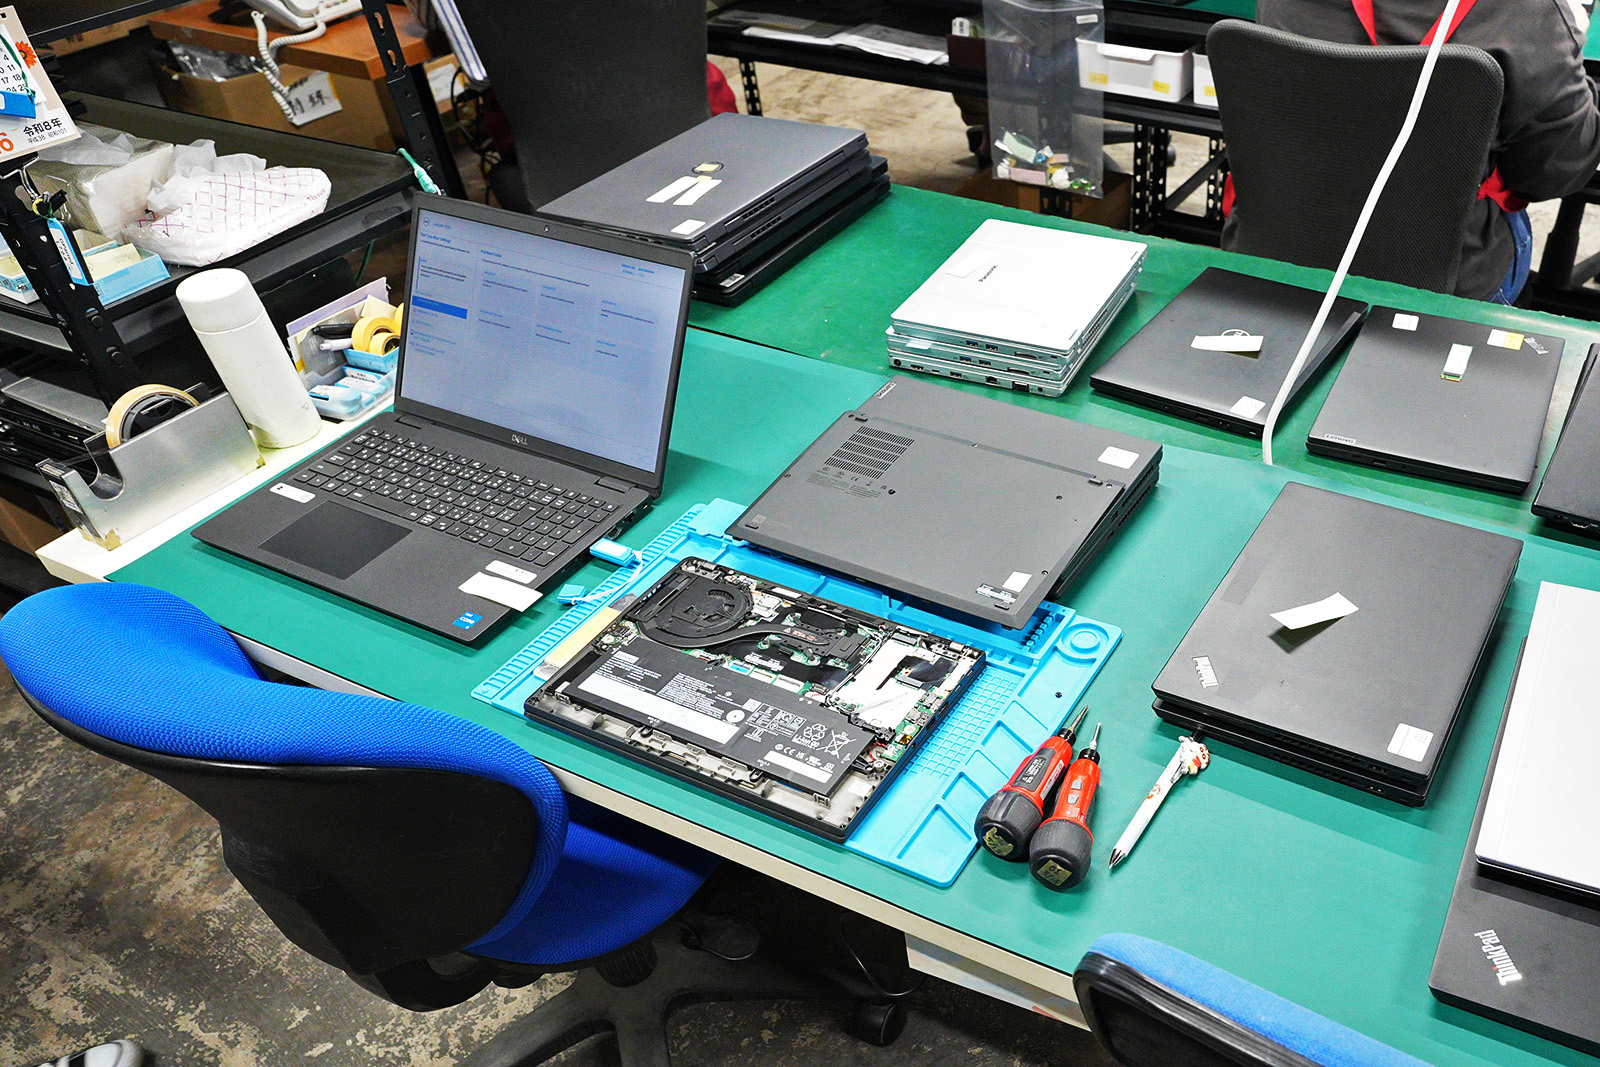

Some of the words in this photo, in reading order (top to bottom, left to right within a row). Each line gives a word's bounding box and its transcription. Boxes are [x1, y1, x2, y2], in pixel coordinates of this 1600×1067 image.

[7, 64, 16, 72] 11
[1, 76, 9, 84] 17
[12, 73, 22, 82] 18
[23, 117, 62, 137] 令和8年
[511, 433, 528, 446] DELL
[1473, 928, 1523, 987] ThinkPad
